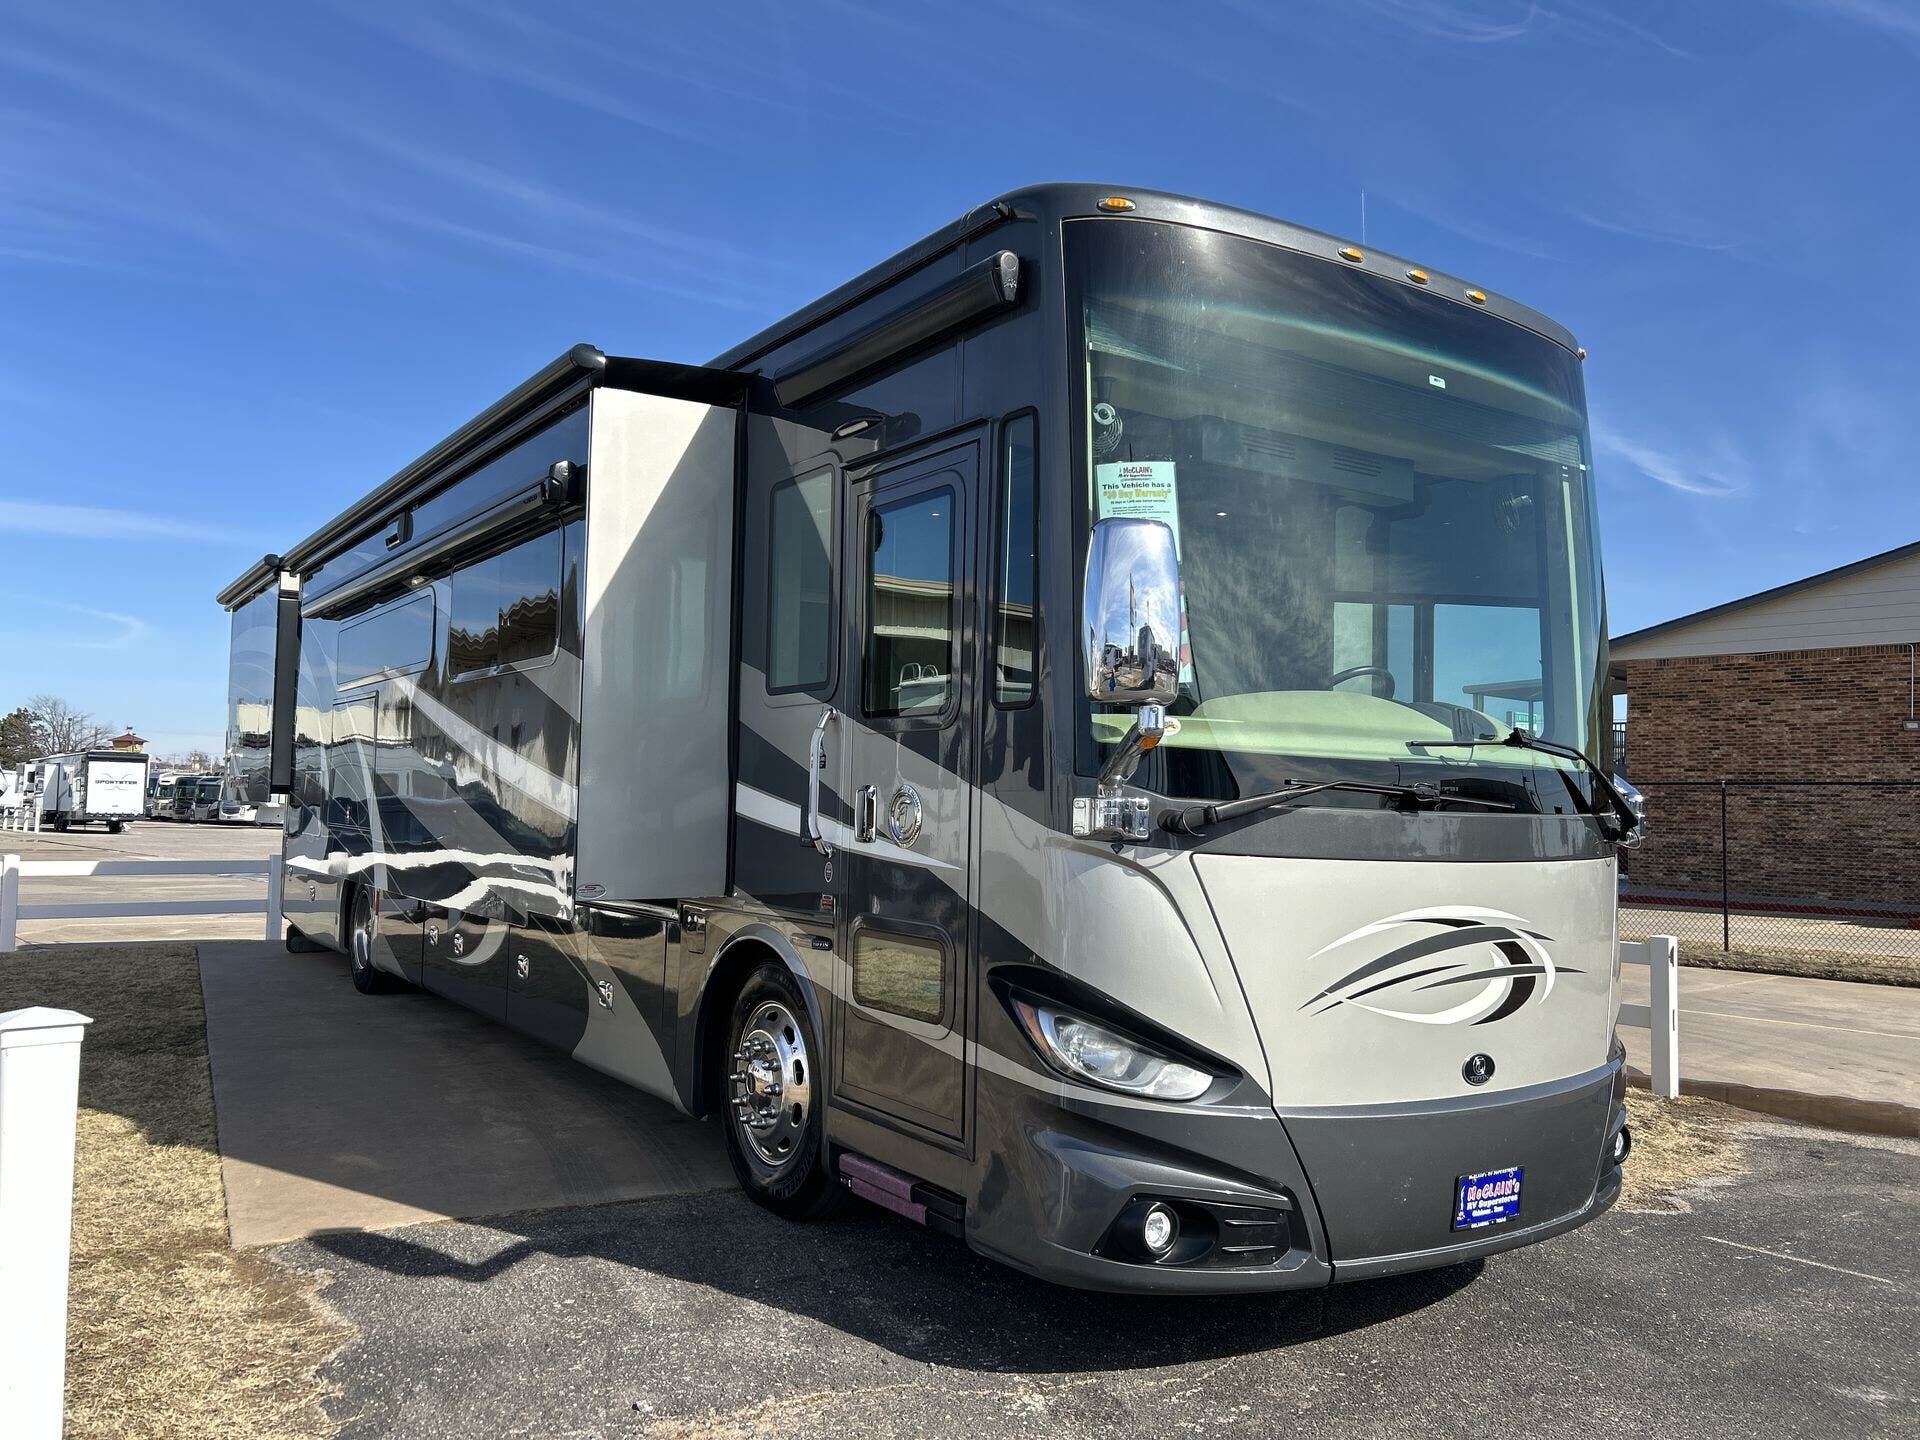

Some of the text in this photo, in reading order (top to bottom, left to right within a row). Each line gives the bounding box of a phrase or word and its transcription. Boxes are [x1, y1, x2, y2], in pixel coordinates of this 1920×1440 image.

[1121, 481, 1150, 489] Vehicle
[1118, 489, 1133, 499] Day
[1466, 1194, 1519, 1210] RV Superstores
